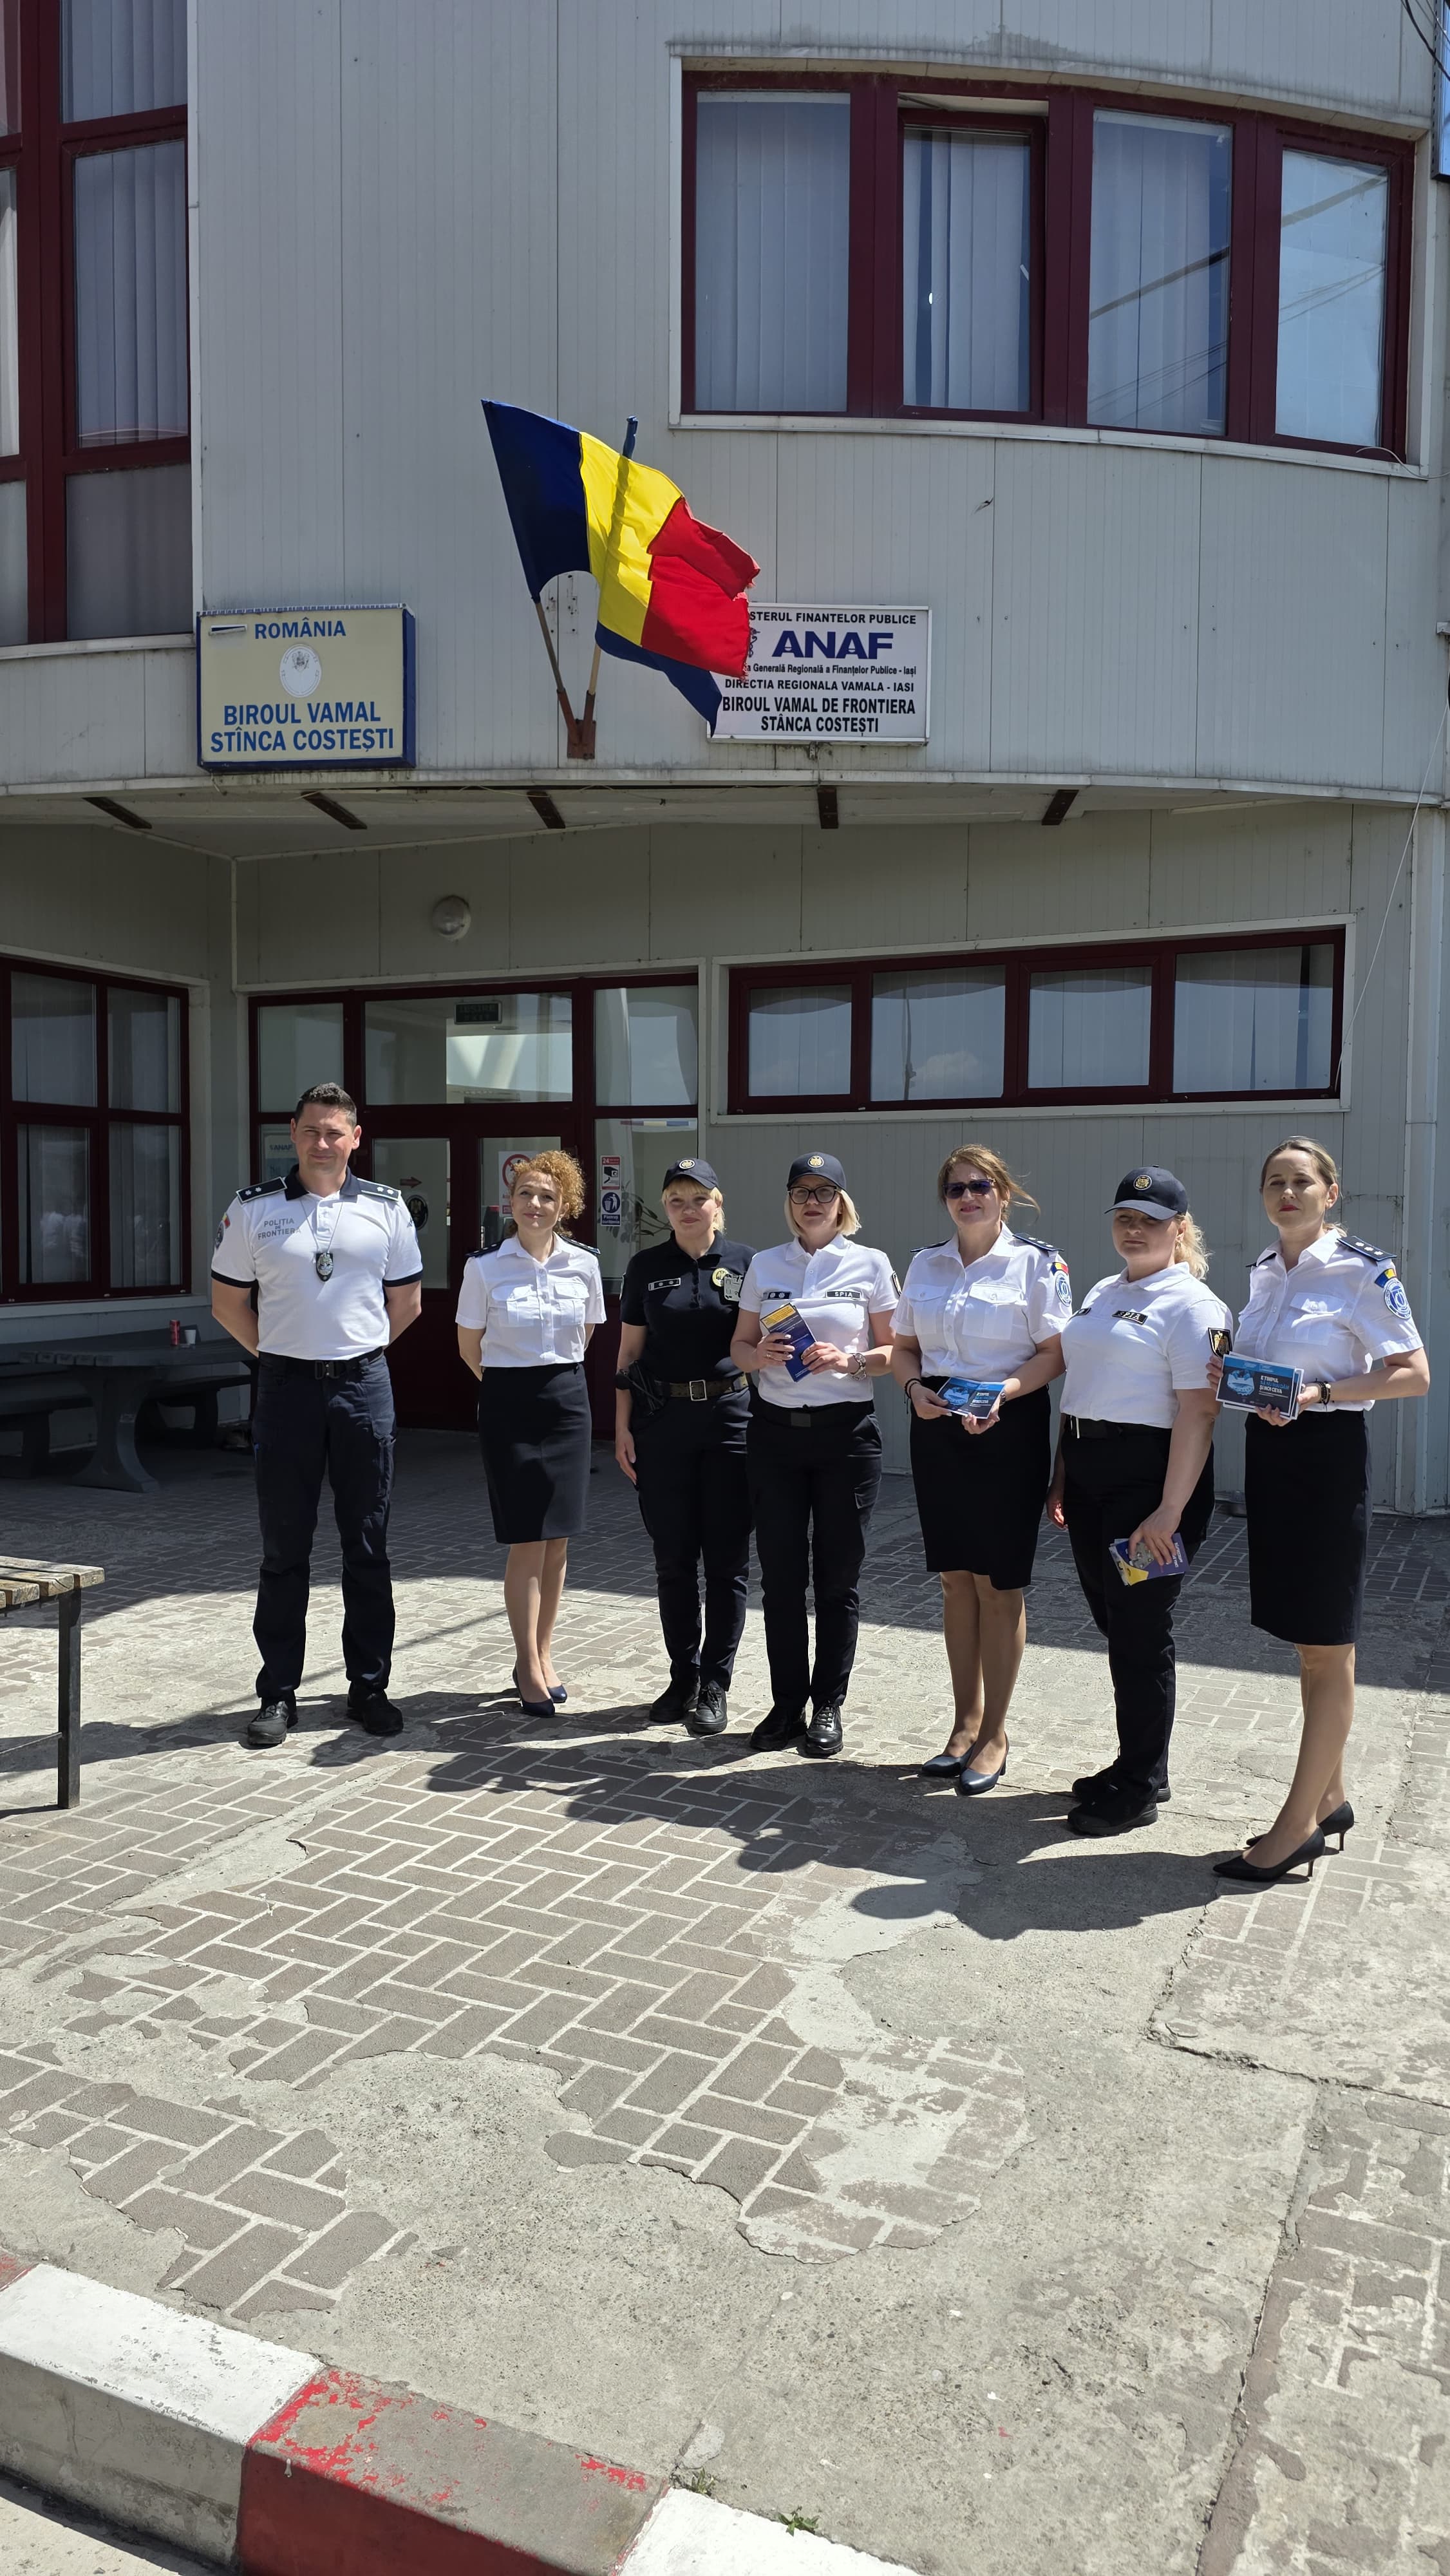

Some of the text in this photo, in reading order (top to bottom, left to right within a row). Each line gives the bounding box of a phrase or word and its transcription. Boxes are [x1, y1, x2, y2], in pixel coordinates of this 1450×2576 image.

[254, 617, 346, 639] ROMÂNIA
[749, 611, 917, 625] STERUL FINANTELOR PUBLICE
[772, 630, 894, 659] ANAF
[753, 663, 786, 672] Generală
[787, 664, 824, 675] Regională
[833, 665, 869, 676] Finanțelor
[871, 666, 897, 675] Publice
[904, 666, 916, 677] Iași
[725, 678, 774, 689] DIRECTIA
[777, 679, 838, 691] REGIONALA
[842, 681, 884, 691] VAMALA
[894, 683, 914, 692] IASI
[224, 701, 381, 725] BIROUL VAMAL
[722, 696, 916, 714] BIROUL VAMAL DE FRONTIERA
[761, 714, 879, 737] STÂNCA COSTEȘTI
[211, 726, 393, 752] STÎNCA COSTEȘTI
[1117, 1312, 1140, 1320] SPIA
